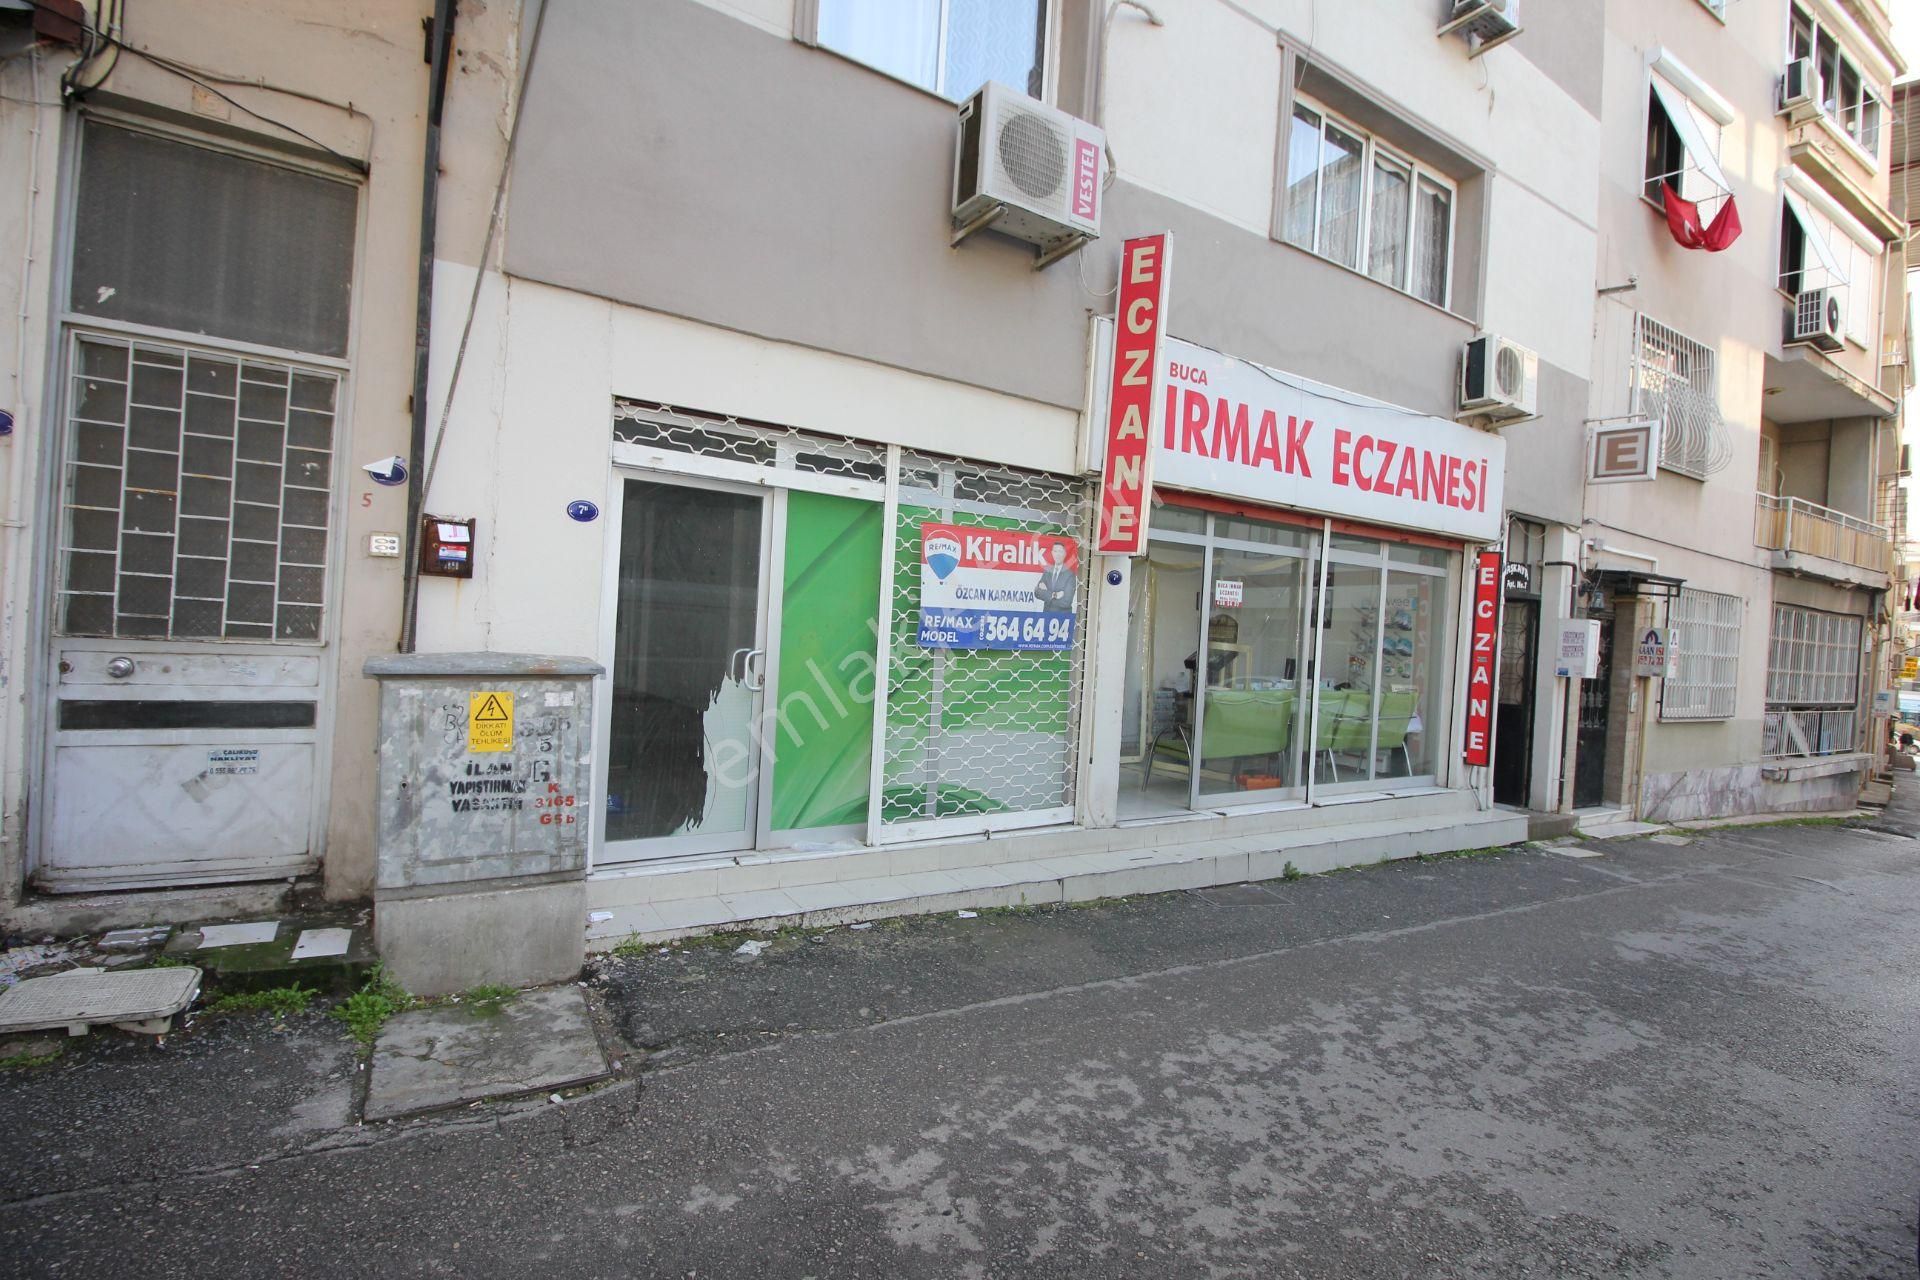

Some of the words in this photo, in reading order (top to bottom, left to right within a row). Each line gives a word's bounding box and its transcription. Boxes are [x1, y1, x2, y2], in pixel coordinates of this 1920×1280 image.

[1079, 146, 1095, 214] VESTEL
[1169, 361, 1208, 386] BUCA
[1109, 245, 1156, 541] ECZANE
[1163, 384, 1314, 478] IRMAK
[1332, 428, 1488, 513] ECZANESİ
[1605, 434, 1639, 471] E
[361, 492, 373, 508] 5
[928, 543, 957, 553] RE/MAX
[966, 535, 1047, 566] Kiralık
[955, 585, 986, 601] ÖZCAN
[988, 591, 1035, 603] KARAKAYA
[925, 615, 974, 629] RE/MAX
[986, 615, 1020, 641] 364
[1023, 617, 1045, 641] 64
[1048, 618, 1070, 642] 94
[921, 630, 959, 643] MODEL
[1469, 567, 1495, 750] ECZANE
[547, 782, 560, 794] K
[534, 795, 574, 809] 3165
